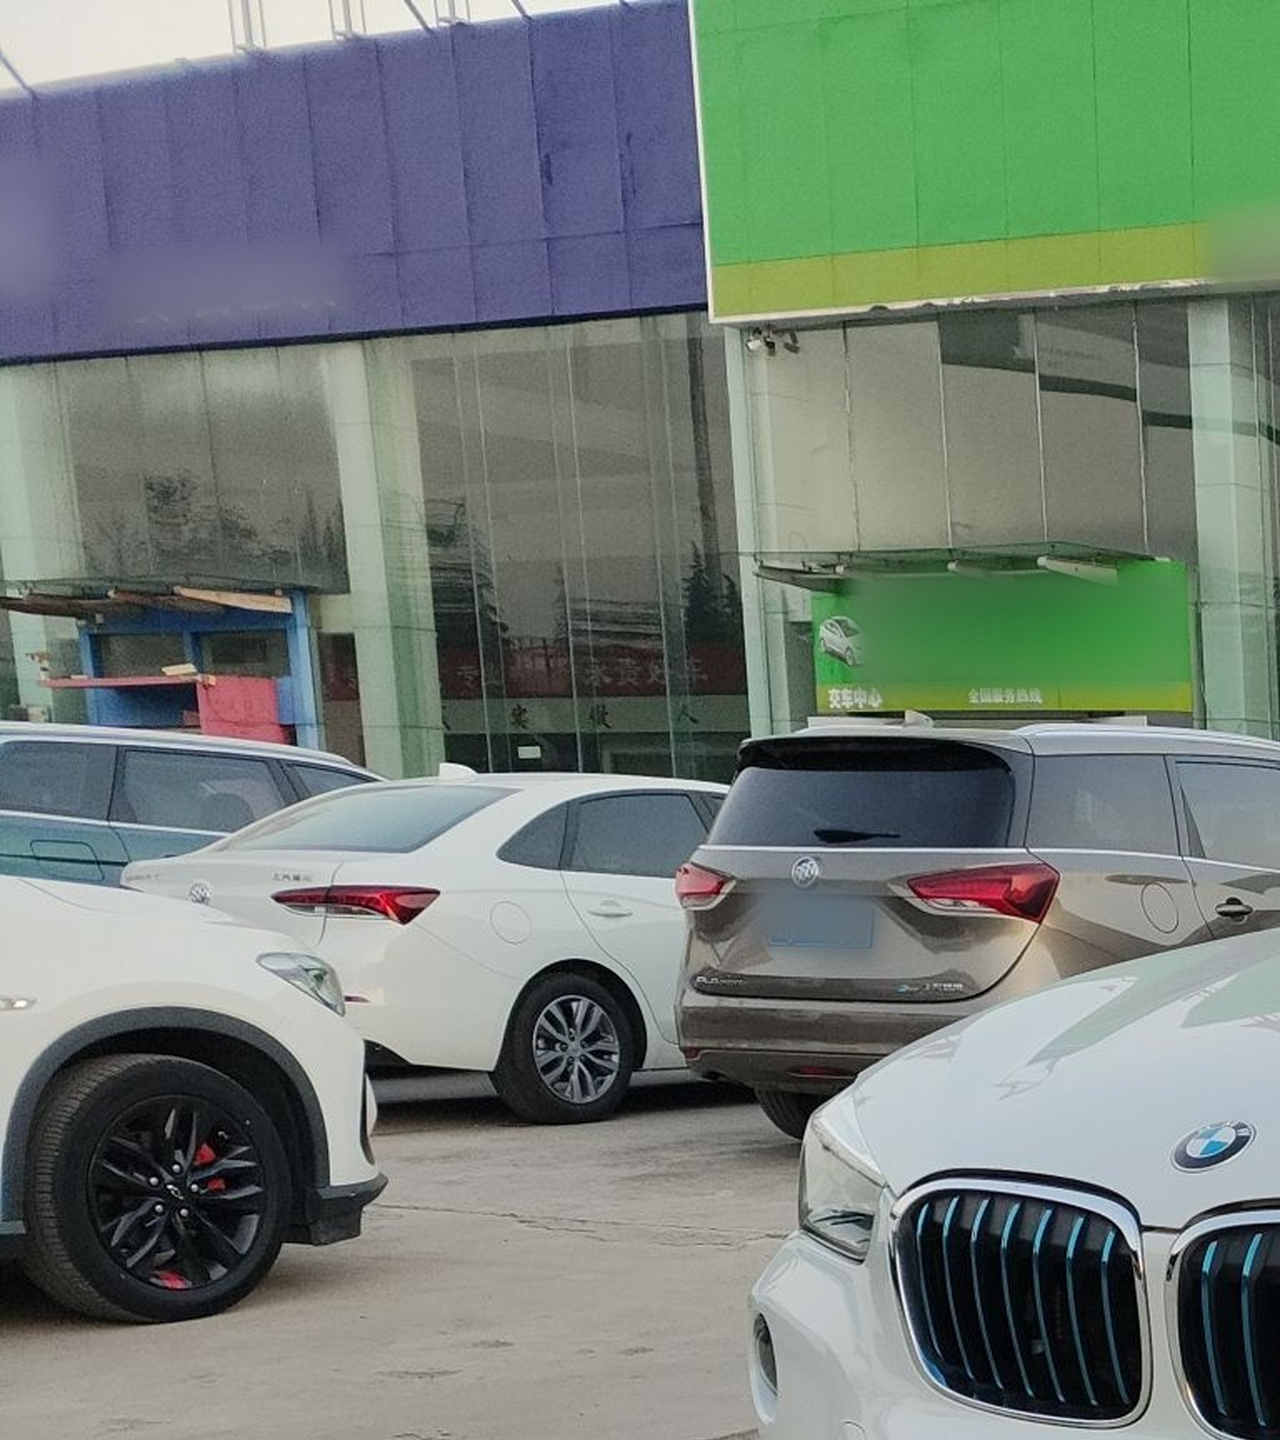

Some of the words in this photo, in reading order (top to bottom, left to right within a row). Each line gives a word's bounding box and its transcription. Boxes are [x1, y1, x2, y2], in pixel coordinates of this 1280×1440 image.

[828, 687, 882, 709] 交车中心
[967, 687, 1043, 704] 全国服务热线
